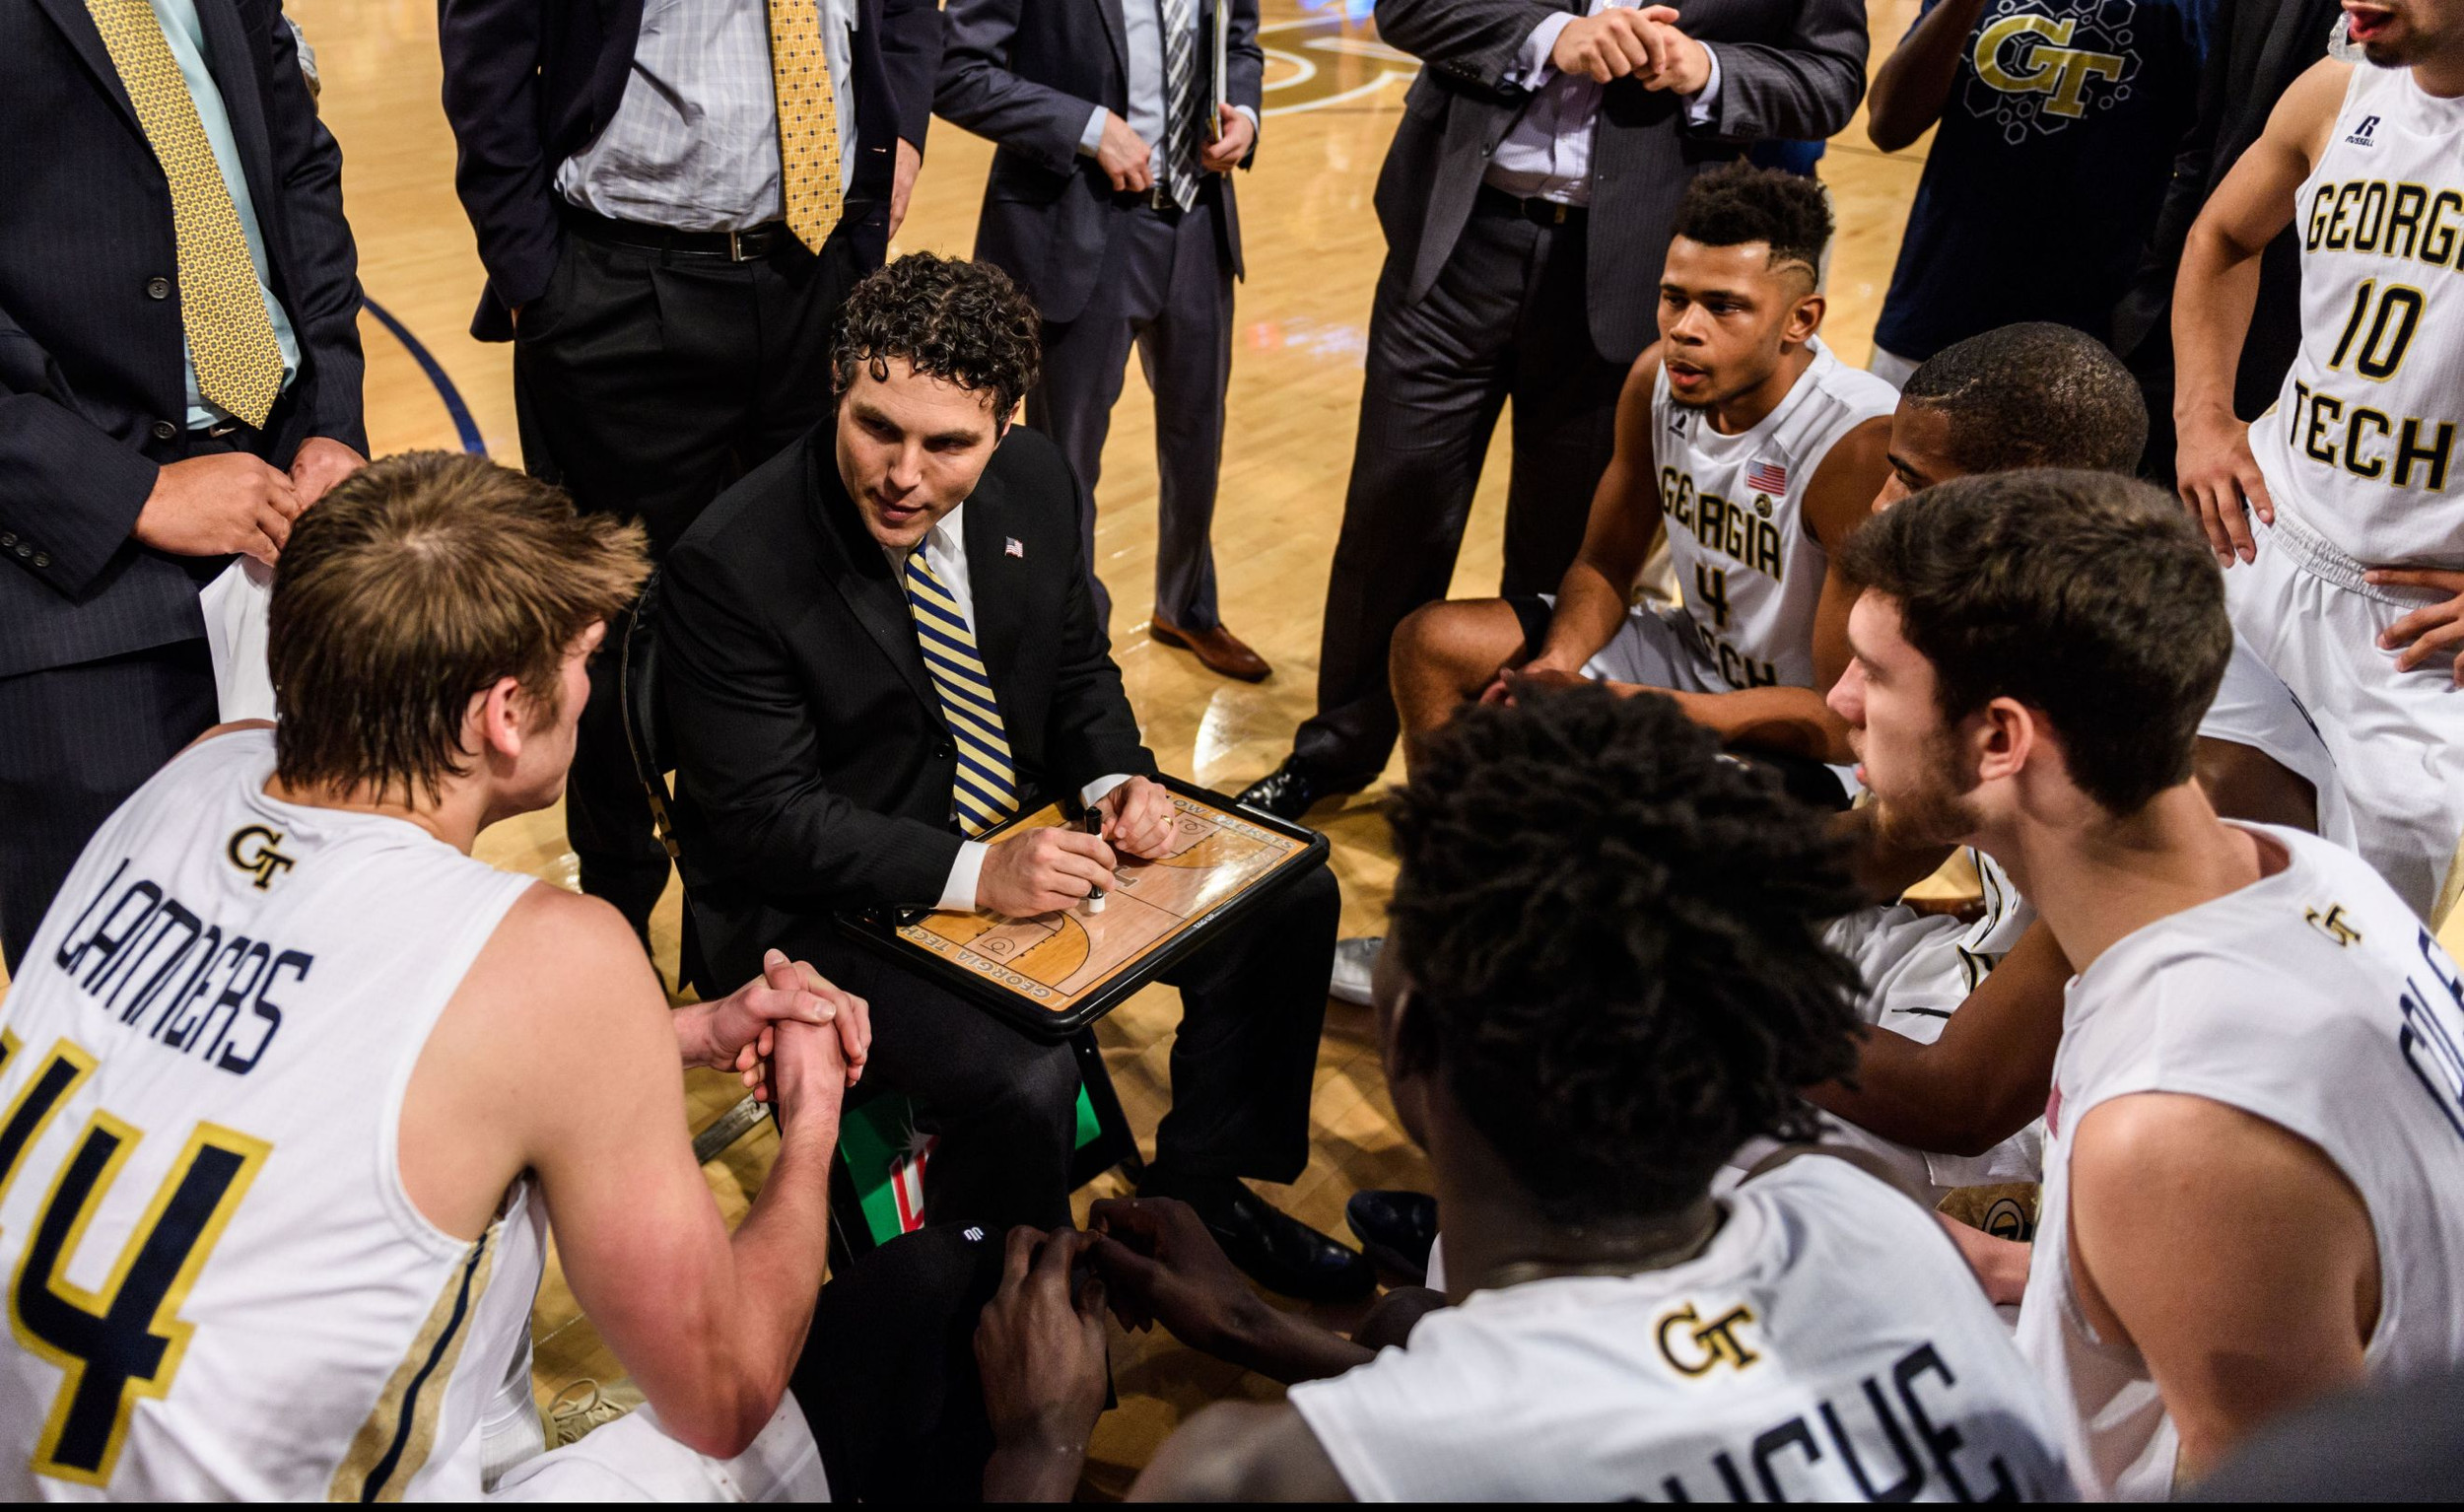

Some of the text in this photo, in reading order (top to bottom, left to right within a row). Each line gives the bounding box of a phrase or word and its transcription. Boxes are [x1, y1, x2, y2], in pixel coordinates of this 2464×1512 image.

[1974, 14, 2125, 119] GT
[2327, 278, 2428, 383] 10
[2290, 378, 2456, 493] TECH
[1695, 562, 1732, 629] 4
[226, 823, 297, 893] GT
[898, 925, 1053, 999] GEORGIA TECH
[1654, 1300, 1761, 1380] GT
